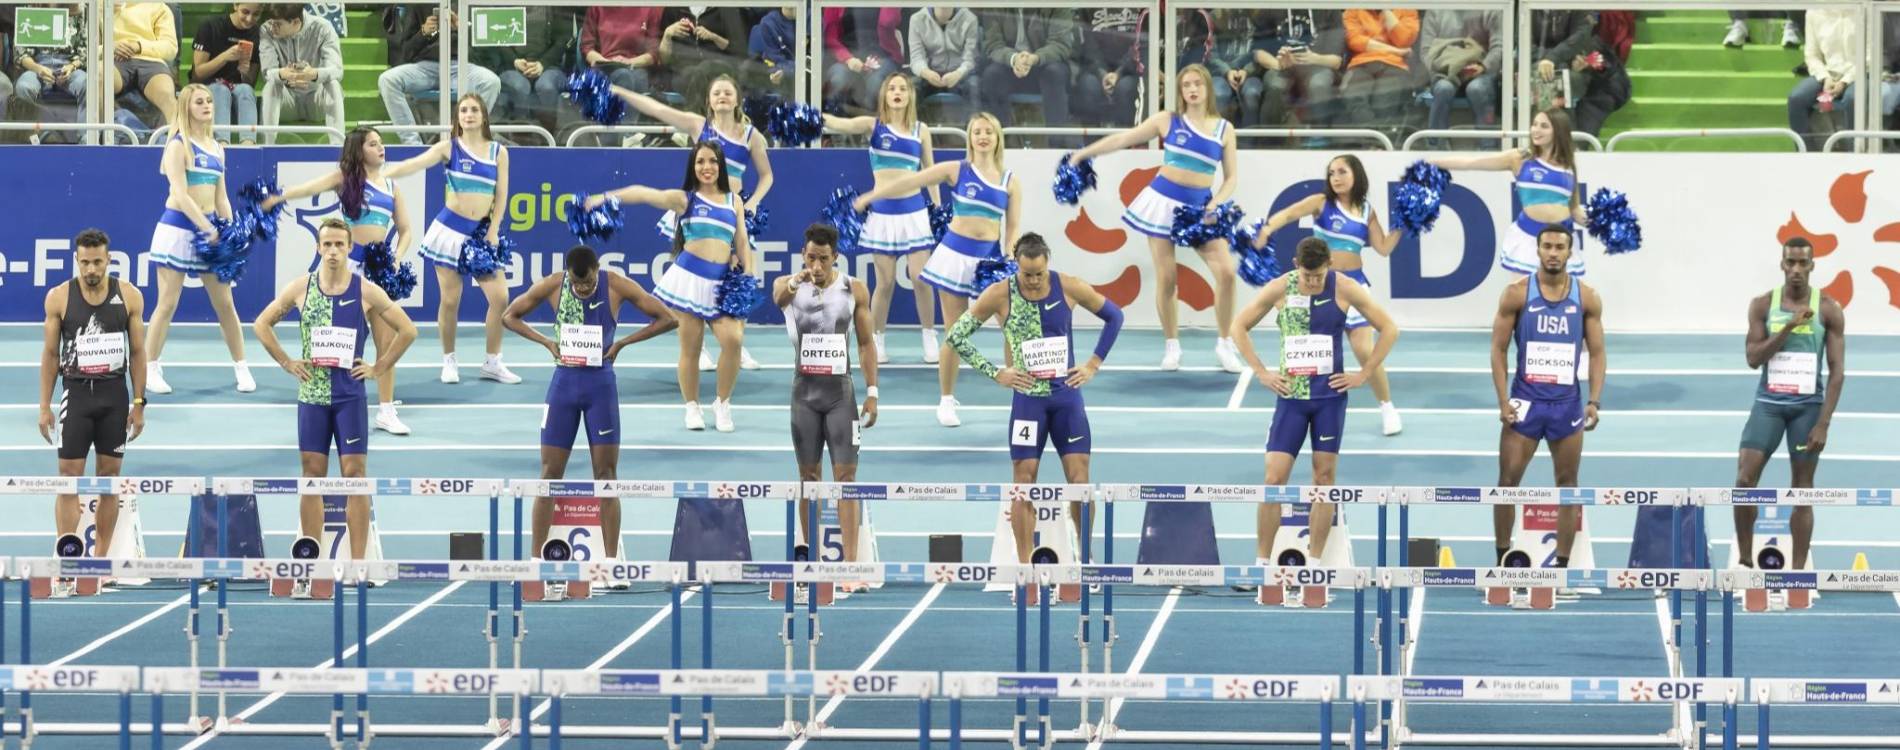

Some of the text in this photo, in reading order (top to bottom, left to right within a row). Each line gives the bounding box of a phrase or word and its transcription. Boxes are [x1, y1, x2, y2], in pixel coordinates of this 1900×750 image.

[1536, 314, 1569, 335] USA
[311, 341, 353, 350] TRAJKOVIC
[571, 340, 603, 349] YOUHA
[77, 347, 123, 357] DOUVALIDIS
[802, 349, 845, 359] ORTEGA
[1024, 349, 1067, 361] MARTINOT
[1286, 350, 1333, 360] CZYKIER
[1027, 356, 1065, 367] LAGARDE
[1527, 358, 1574, 367] DICKSON
[1018, 426, 1031, 441] 4
[616, 483, 665, 491] Pas de Calais
[908, 486, 957, 494] Pas de Calais
[1207, 486, 1256, 494] Pas de Calais
[1502, 488, 1551, 497] Pas de Calais
[1799, 490, 1847, 498] Pas de Calais
[322, 525, 346, 559] 7
[568, 527, 591, 560] 6
[822, 528, 844, 562] 5
[1541, 532, 1560, 568] 2
[819, 565, 874, 573] Pas de Calais
[1158, 568, 1214, 577] Pas de Calais
[1501, 571, 1557, 579] Pas de Calais
[1842, 574, 1899, 582] Pas de Calais
[1493, 680, 1559, 690] Pas de Calais
[1806, 692, 1866, 701] Hauts-de-France
